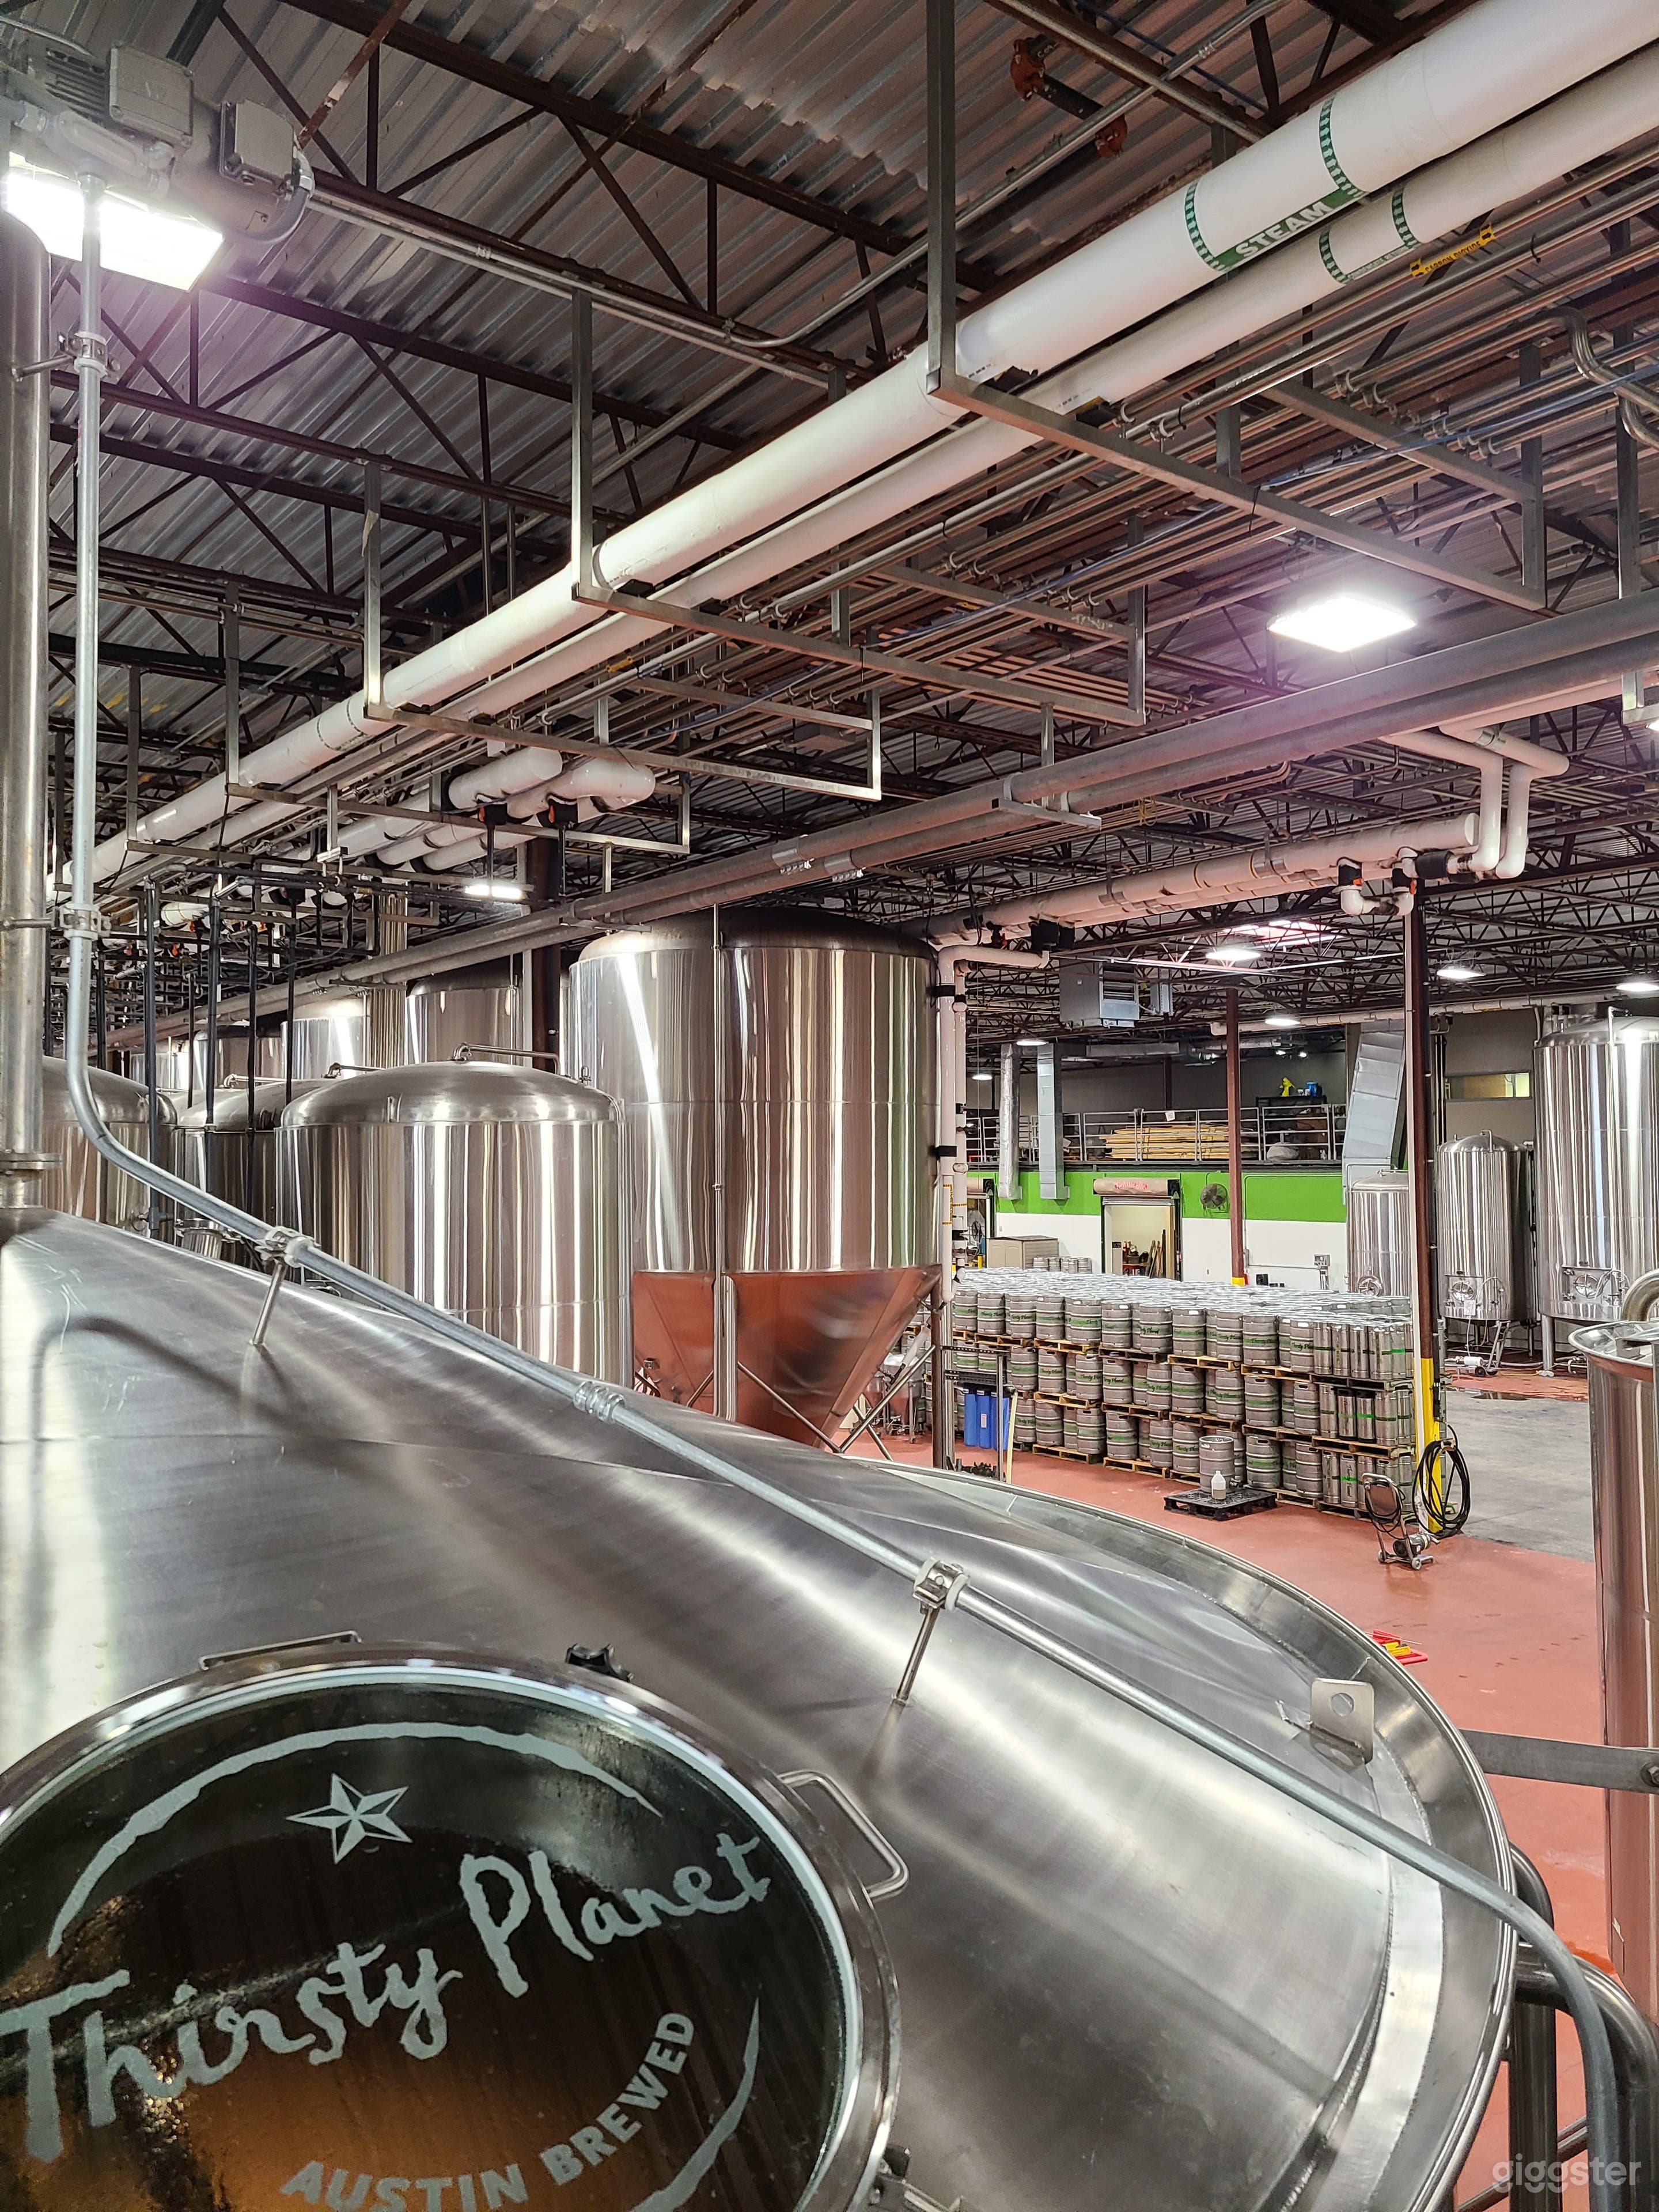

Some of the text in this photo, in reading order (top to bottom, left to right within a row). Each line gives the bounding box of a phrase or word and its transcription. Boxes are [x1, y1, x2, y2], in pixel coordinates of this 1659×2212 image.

[1236, 201, 1334, 257] STEAM
[0, 1833, 771, 2164] Thirsty Planet
[280, 2013, 694, 2212] AUSTIN BREWED
